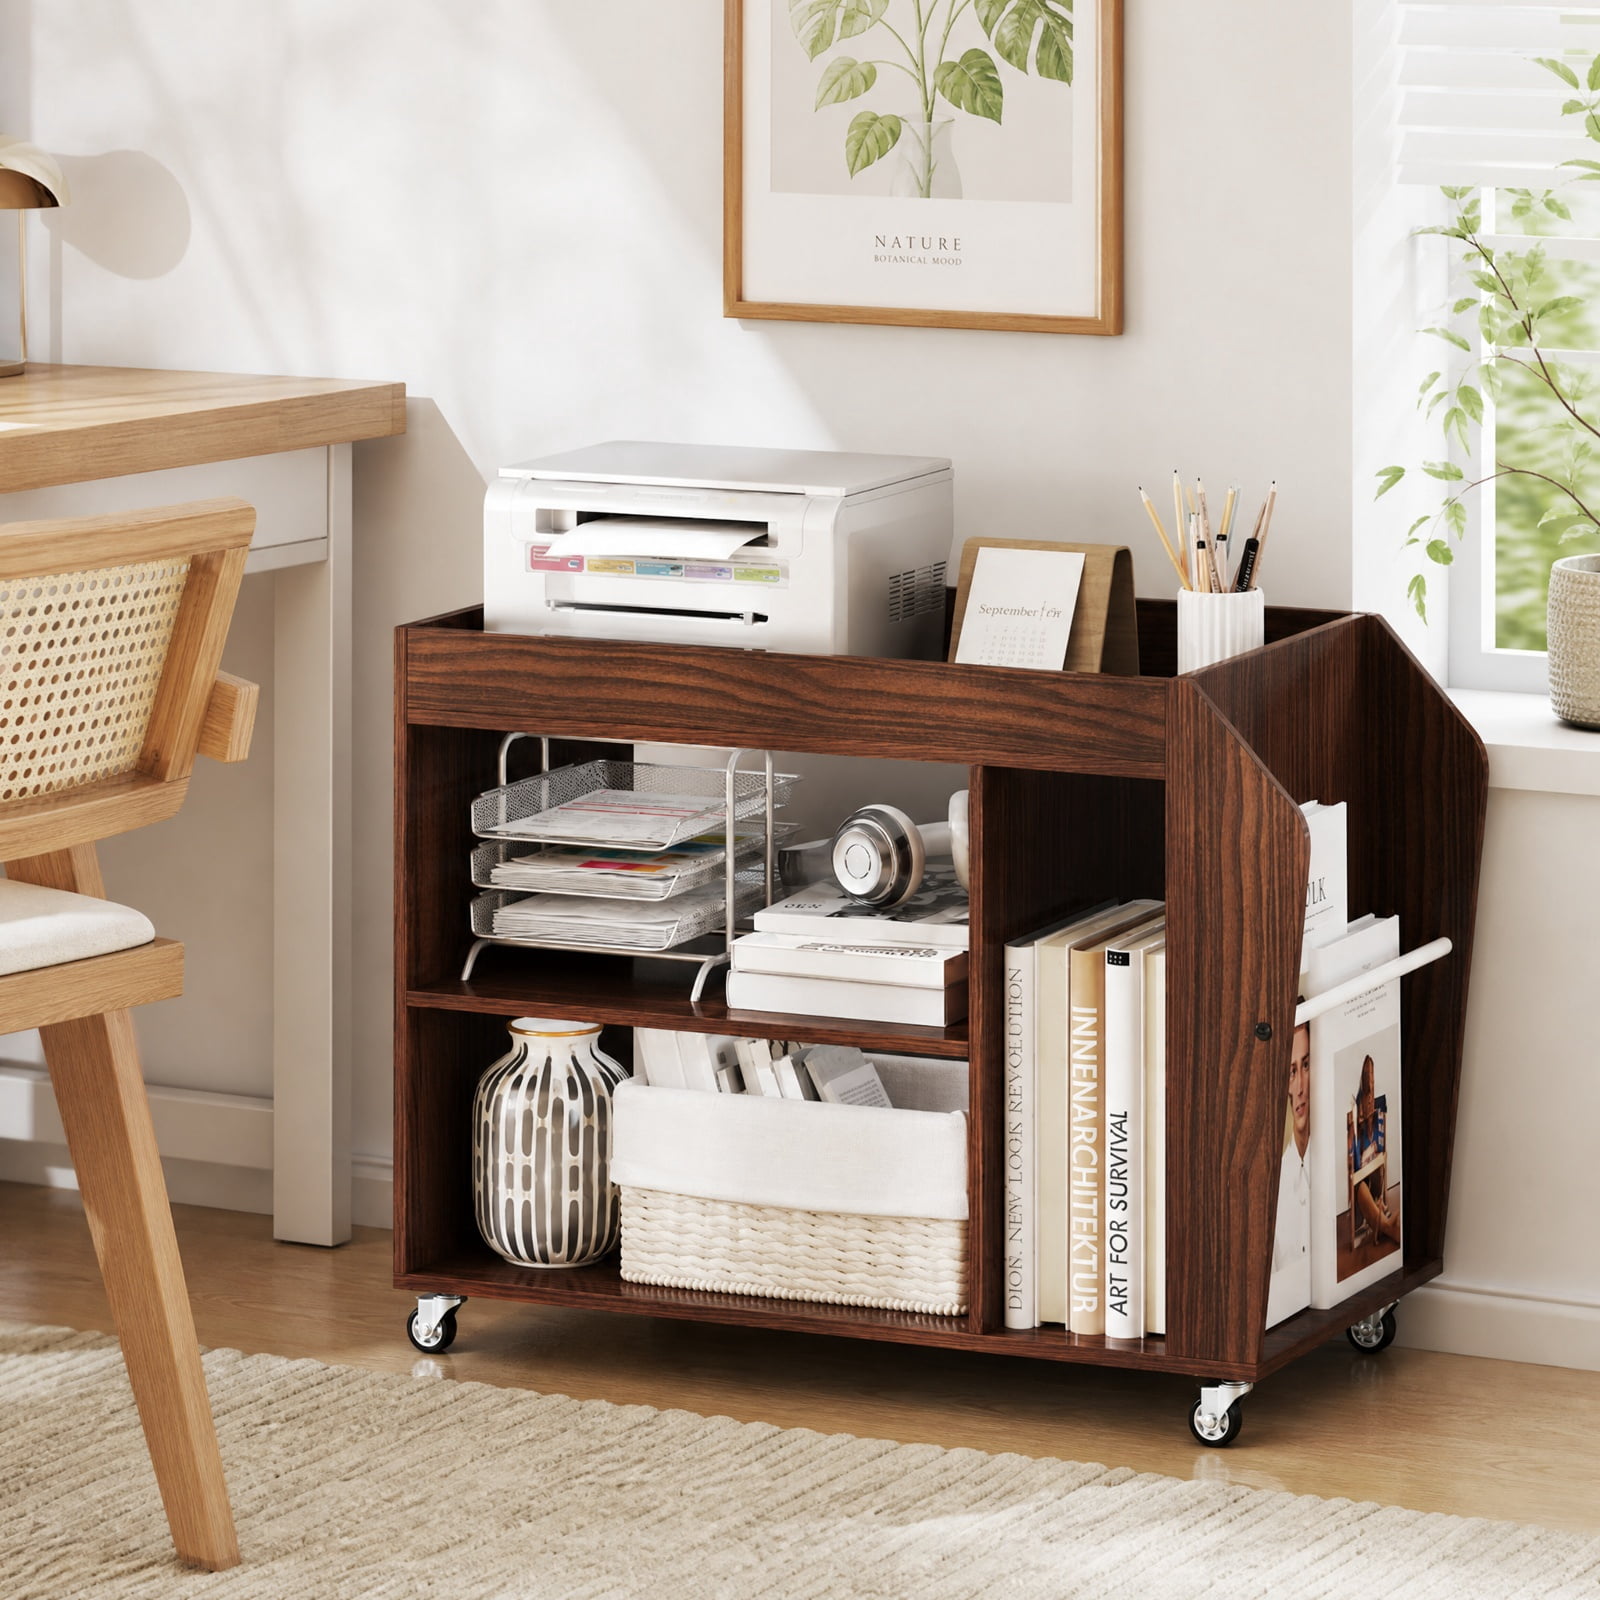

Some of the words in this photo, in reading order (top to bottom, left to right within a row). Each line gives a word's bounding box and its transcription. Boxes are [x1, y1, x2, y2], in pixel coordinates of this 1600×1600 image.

[874, 254, 928, 265] BOTANICAL
[932, 256, 962, 266] MOOD
[875, 234, 962, 251] NATURE
[978, 603, 1039, 618] September
[1008, 1122, 1023, 1184] LOOK
[1072, 1006, 1098, 1313] INNENARCHITEKTUR
[1109, 1111, 1128, 1212] SURVIVAL
[1109, 1220, 1128, 1265] FOR
[1109, 1272, 1128, 1317] ART
